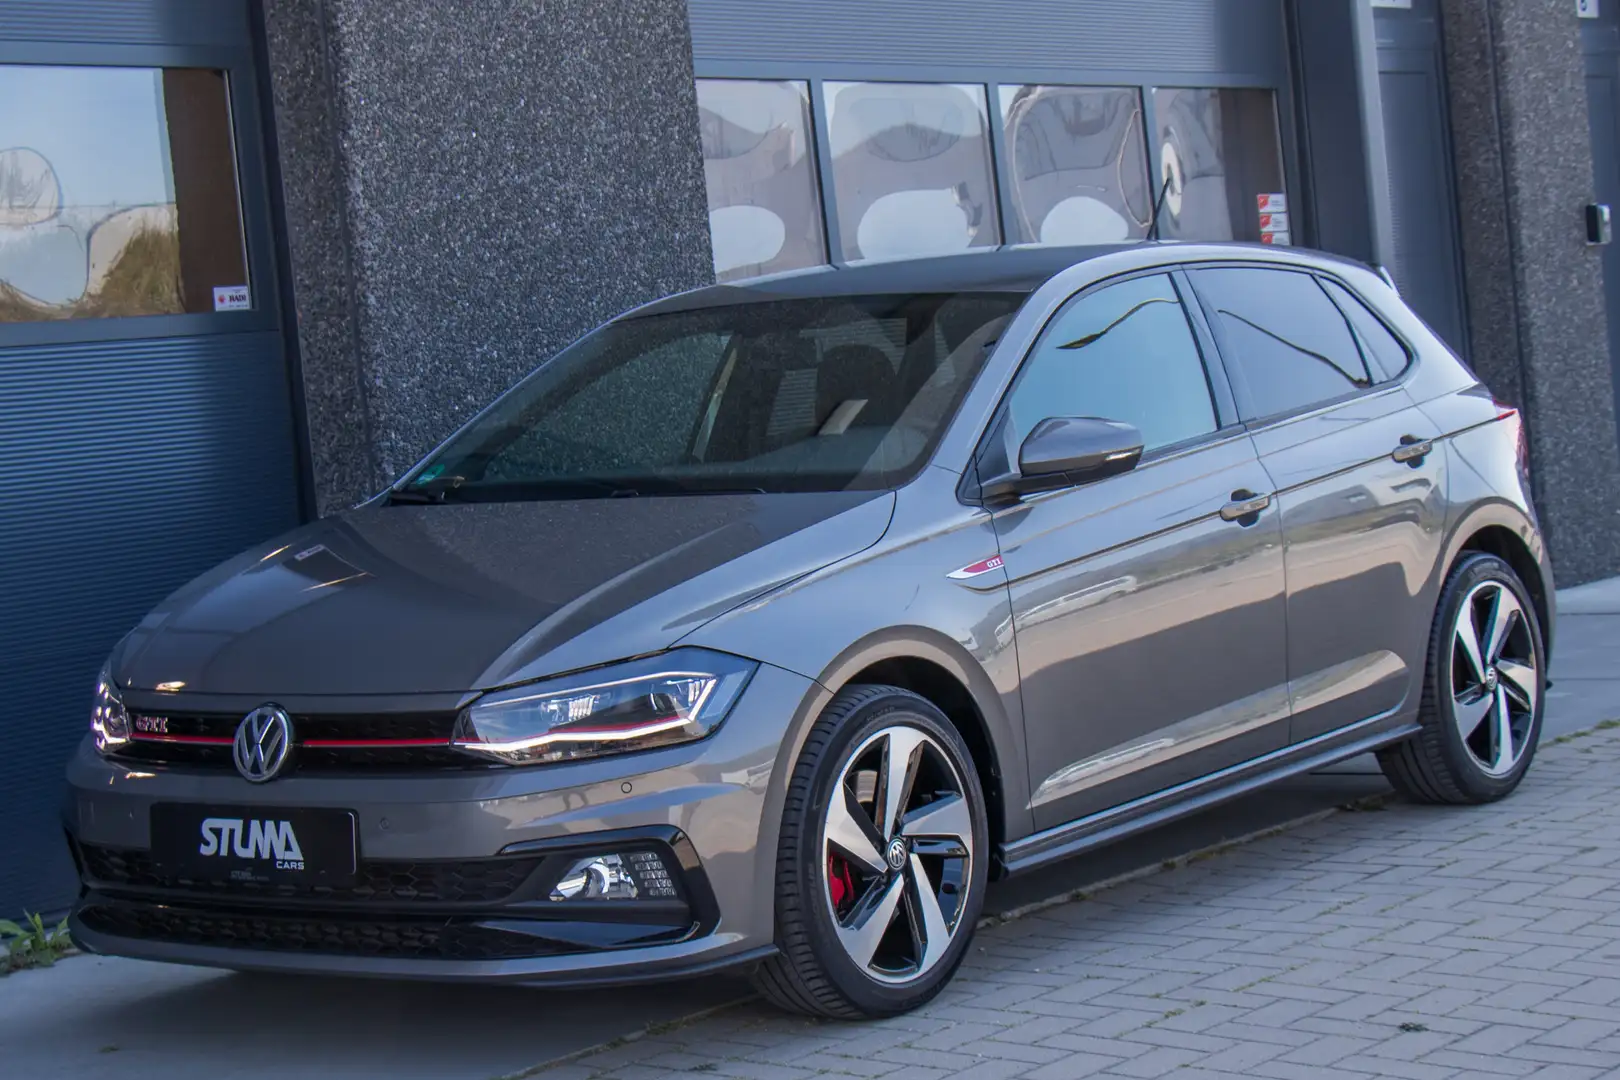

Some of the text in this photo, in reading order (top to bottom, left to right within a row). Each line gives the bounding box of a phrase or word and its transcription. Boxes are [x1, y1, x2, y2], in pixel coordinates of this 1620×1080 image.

[986, 558, 1002, 568] GTI
[136, 716, 169, 733] GTI
[276, 861, 305, 870] CARS
